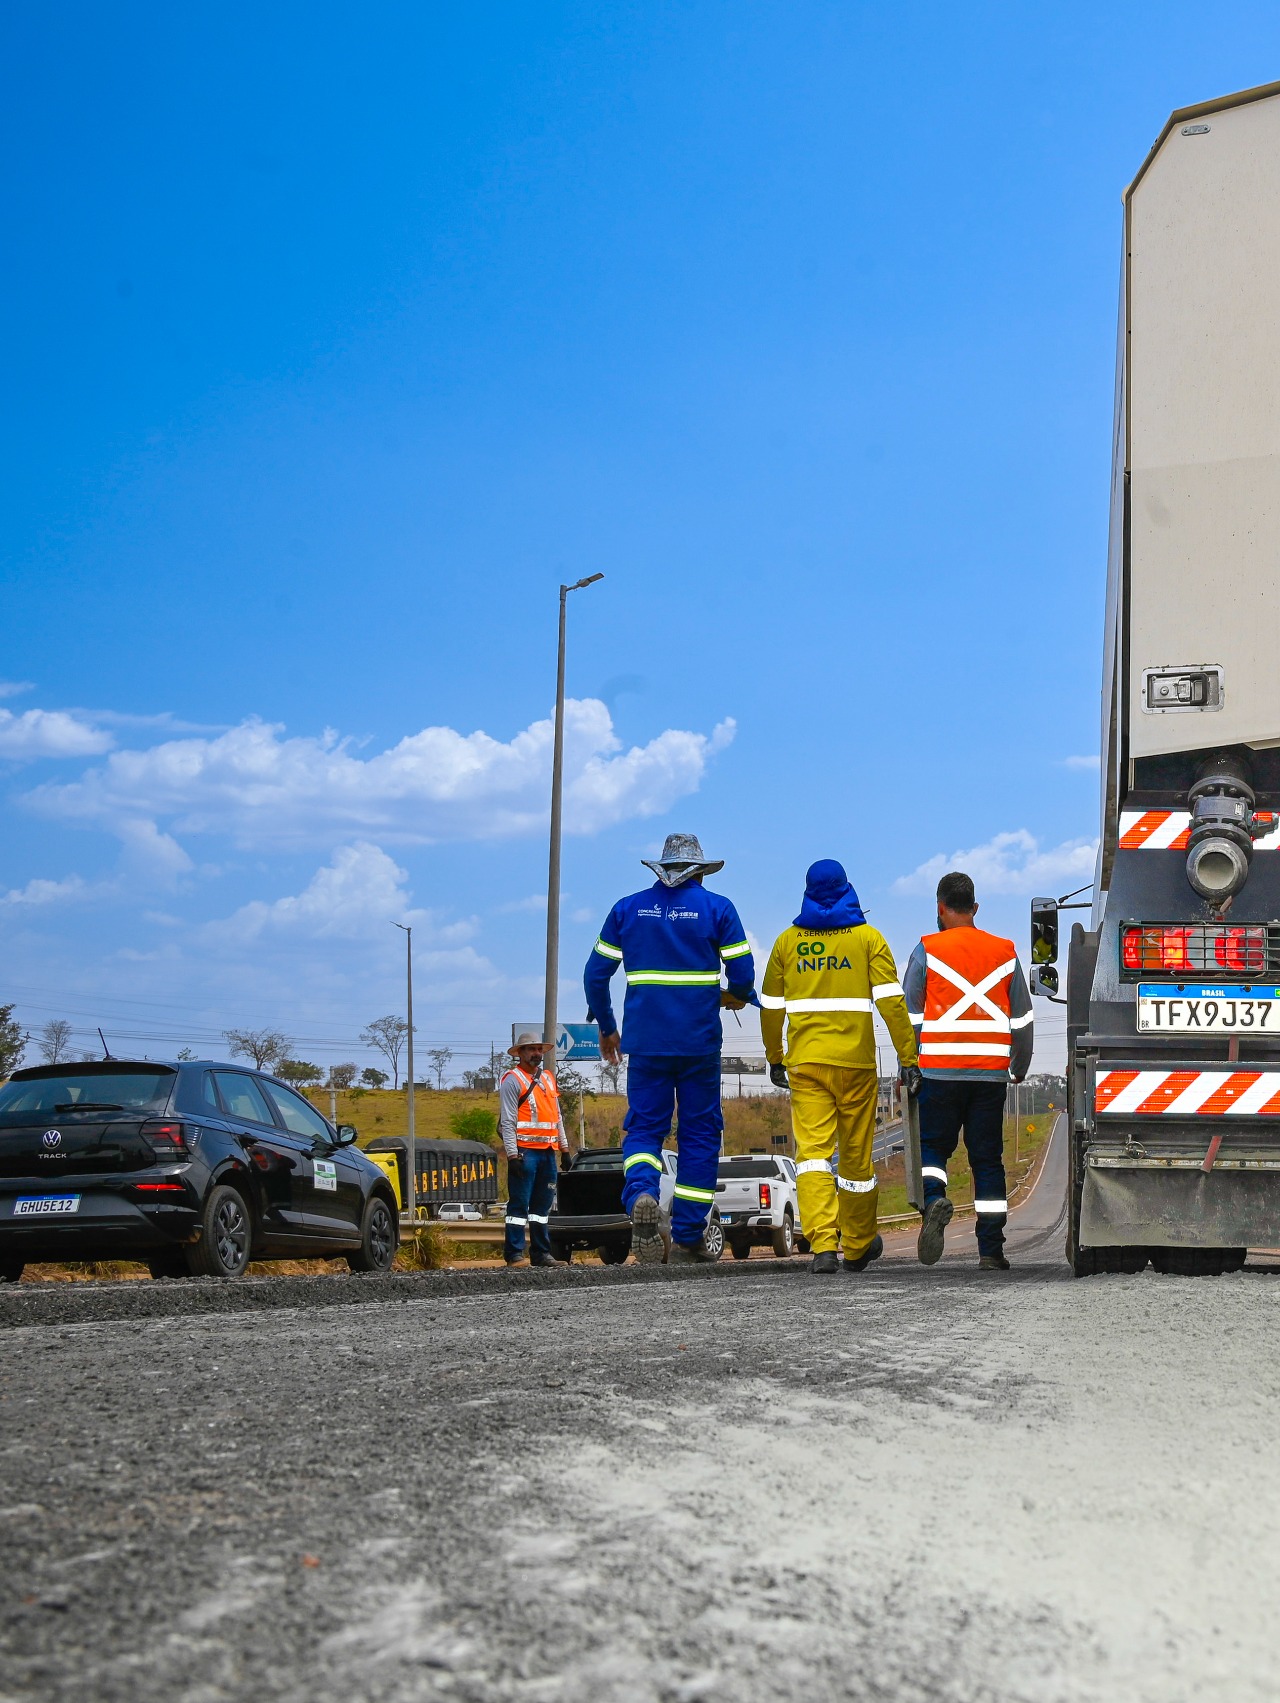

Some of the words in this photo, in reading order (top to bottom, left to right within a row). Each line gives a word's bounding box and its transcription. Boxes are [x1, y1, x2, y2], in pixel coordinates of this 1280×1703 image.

[796, 942, 825, 956] GO
[1151, 1000, 1272, 1026] TFX9J37
[1141, 1020, 1149, 1028] BR
[20, 1200, 73, 1213] GHU5E12
